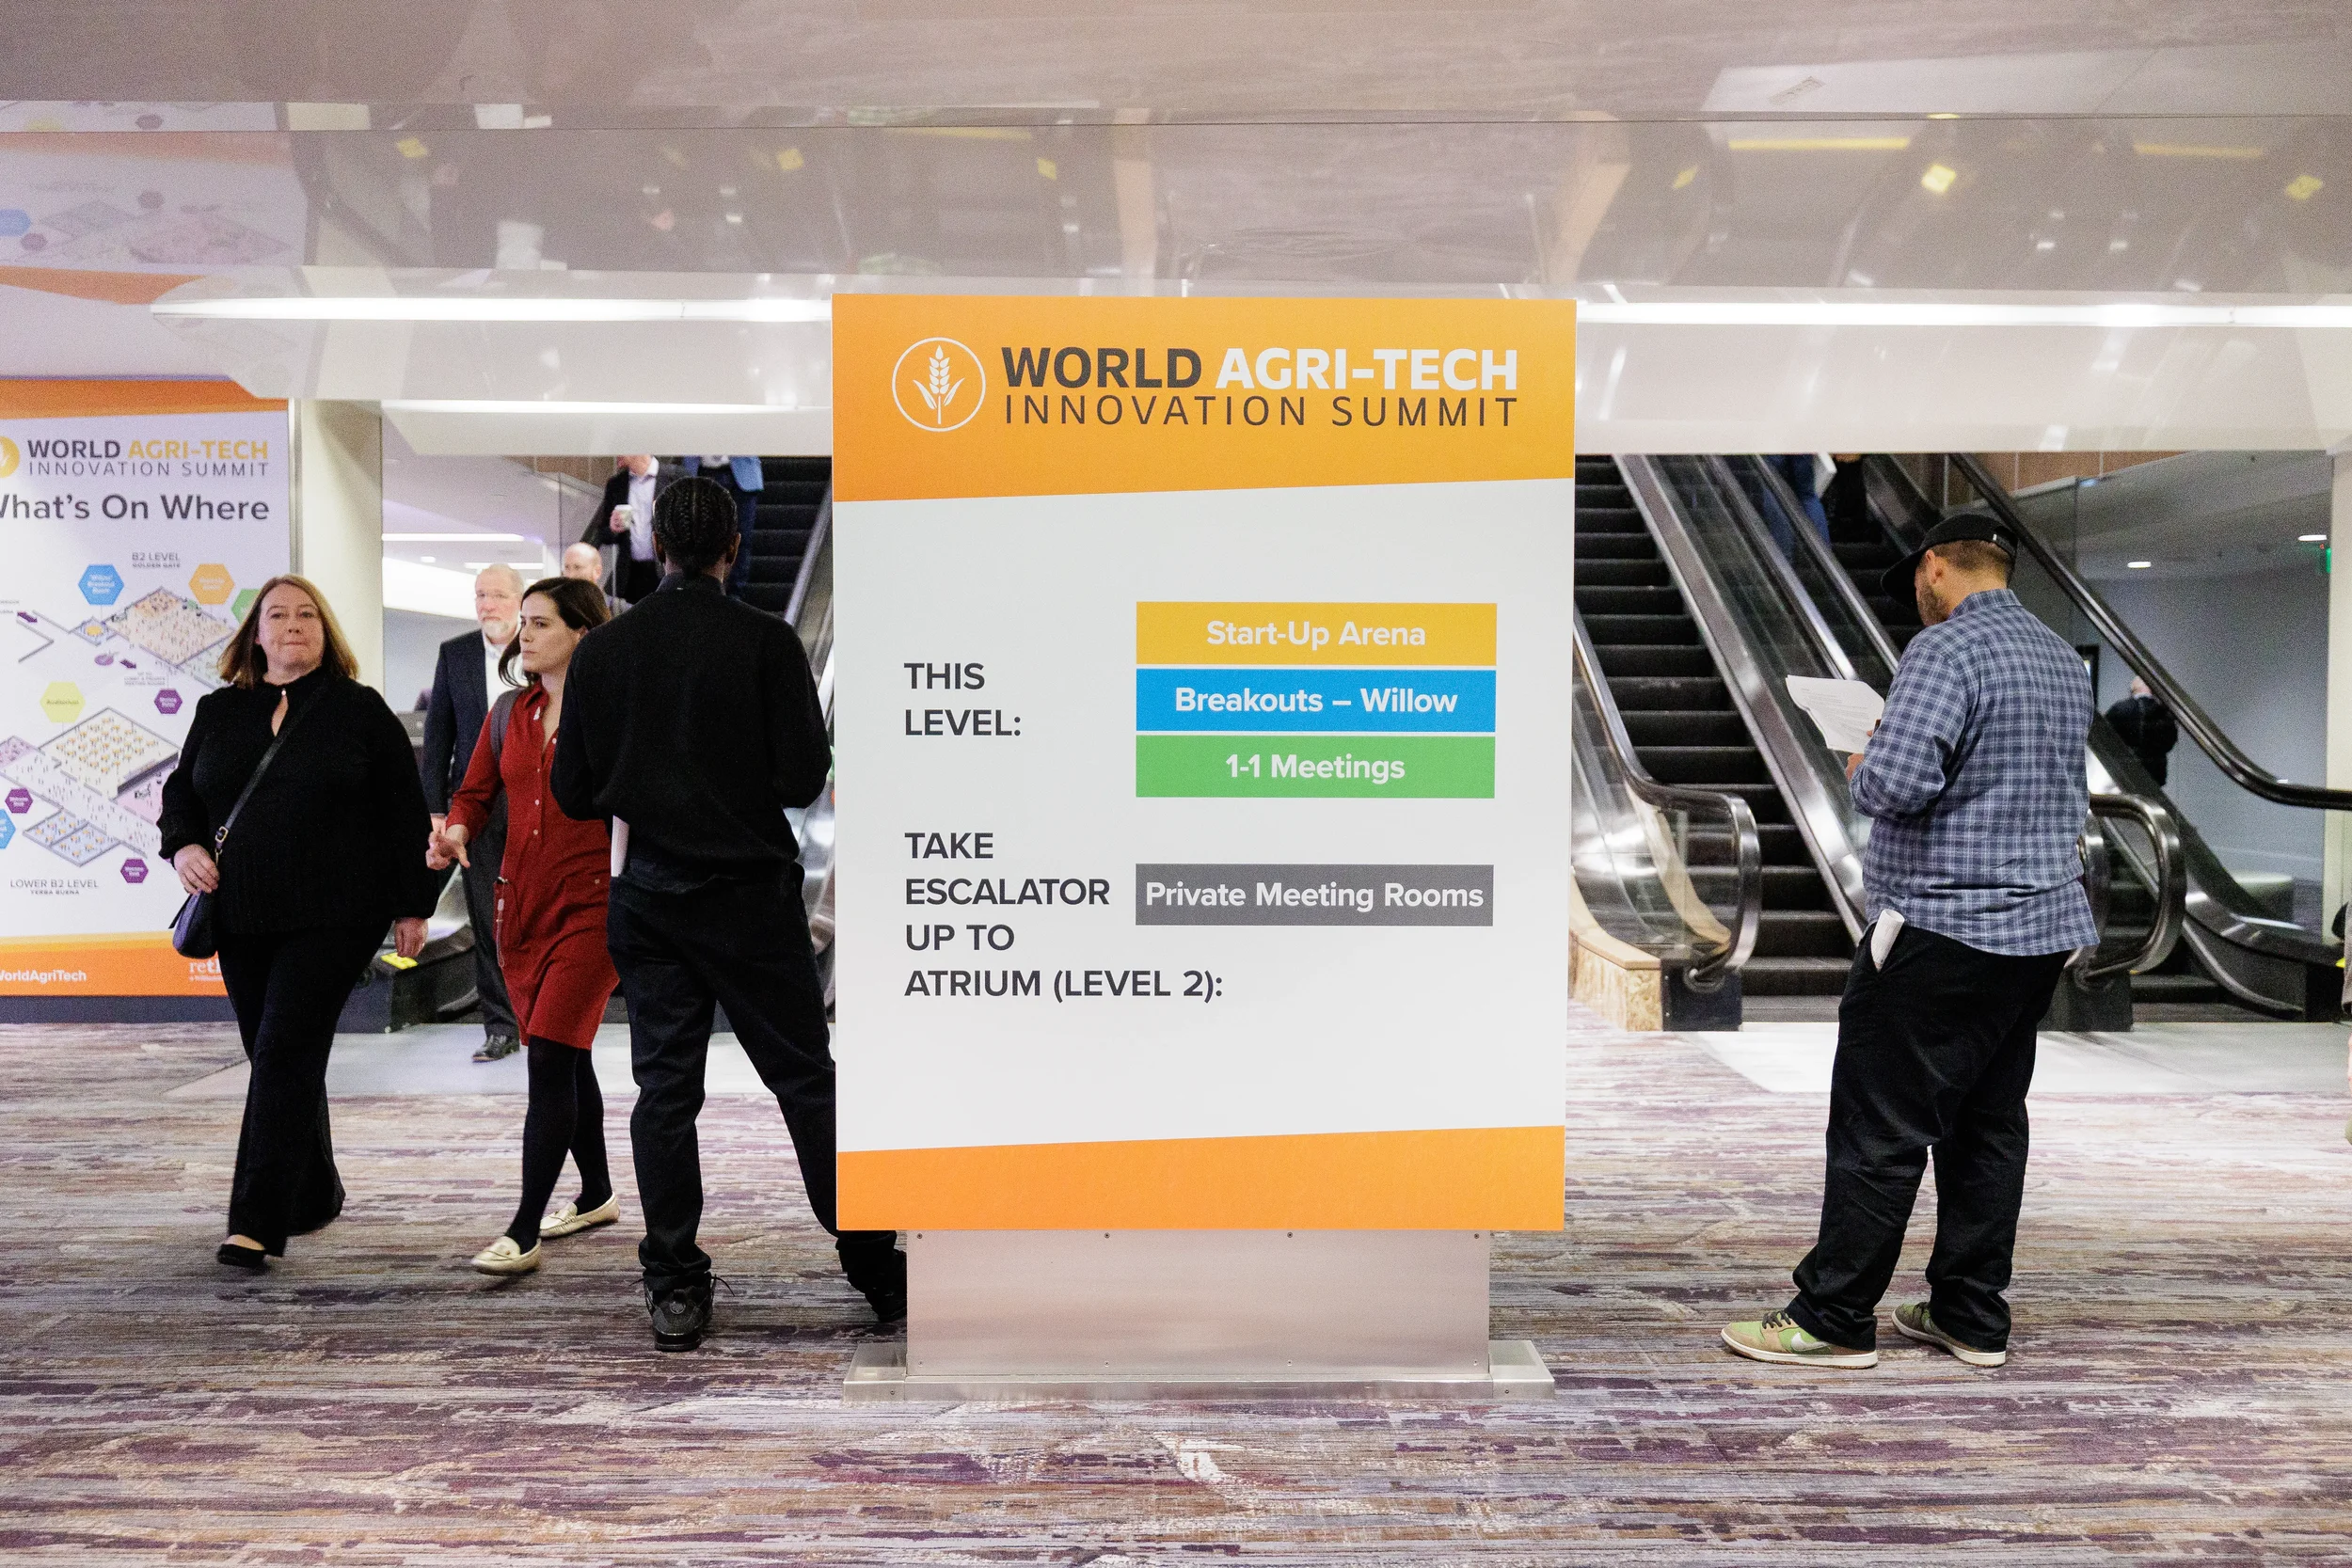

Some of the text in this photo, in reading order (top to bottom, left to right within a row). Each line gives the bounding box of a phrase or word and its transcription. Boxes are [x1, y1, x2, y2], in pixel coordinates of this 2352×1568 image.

[1002, 347, 1518, 390] WORLD AGRI-TECH
[1006, 395, 1518, 426] INNOVATION SUMMIT
[27, 440, 268, 459] WORLD AGRI-TECH
[29, 462, 269, 477] INNOVATION SUMMIT
[102, 494, 148, 520] On
[160, 494, 270, 520] Where
[132, 552, 181, 561] B2 LEVEL
[1206, 620, 1426, 651] Start-Up Arena
[904, 663, 985, 689] THIS
[1175, 687, 1323, 713] Breakouts
[1359, 688, 1458, 713] Willow
[905, 709, 1021, 736] LEVEL:
[1226, 753, 1406, 784] 1-1 Meetings
[905, 832, 993, 859] TAKE
[10, 879, 99, 888] LOWER B2 LEVEL
[905, 878, 1110, 905] ESCALATOR
[1146, 881, 1484, 913] Private Meeting Rooms
[906, 924, 1015, 951] UP TO
[904, 970, 1223, 1004] ATRIUM (LEVEL 2):
